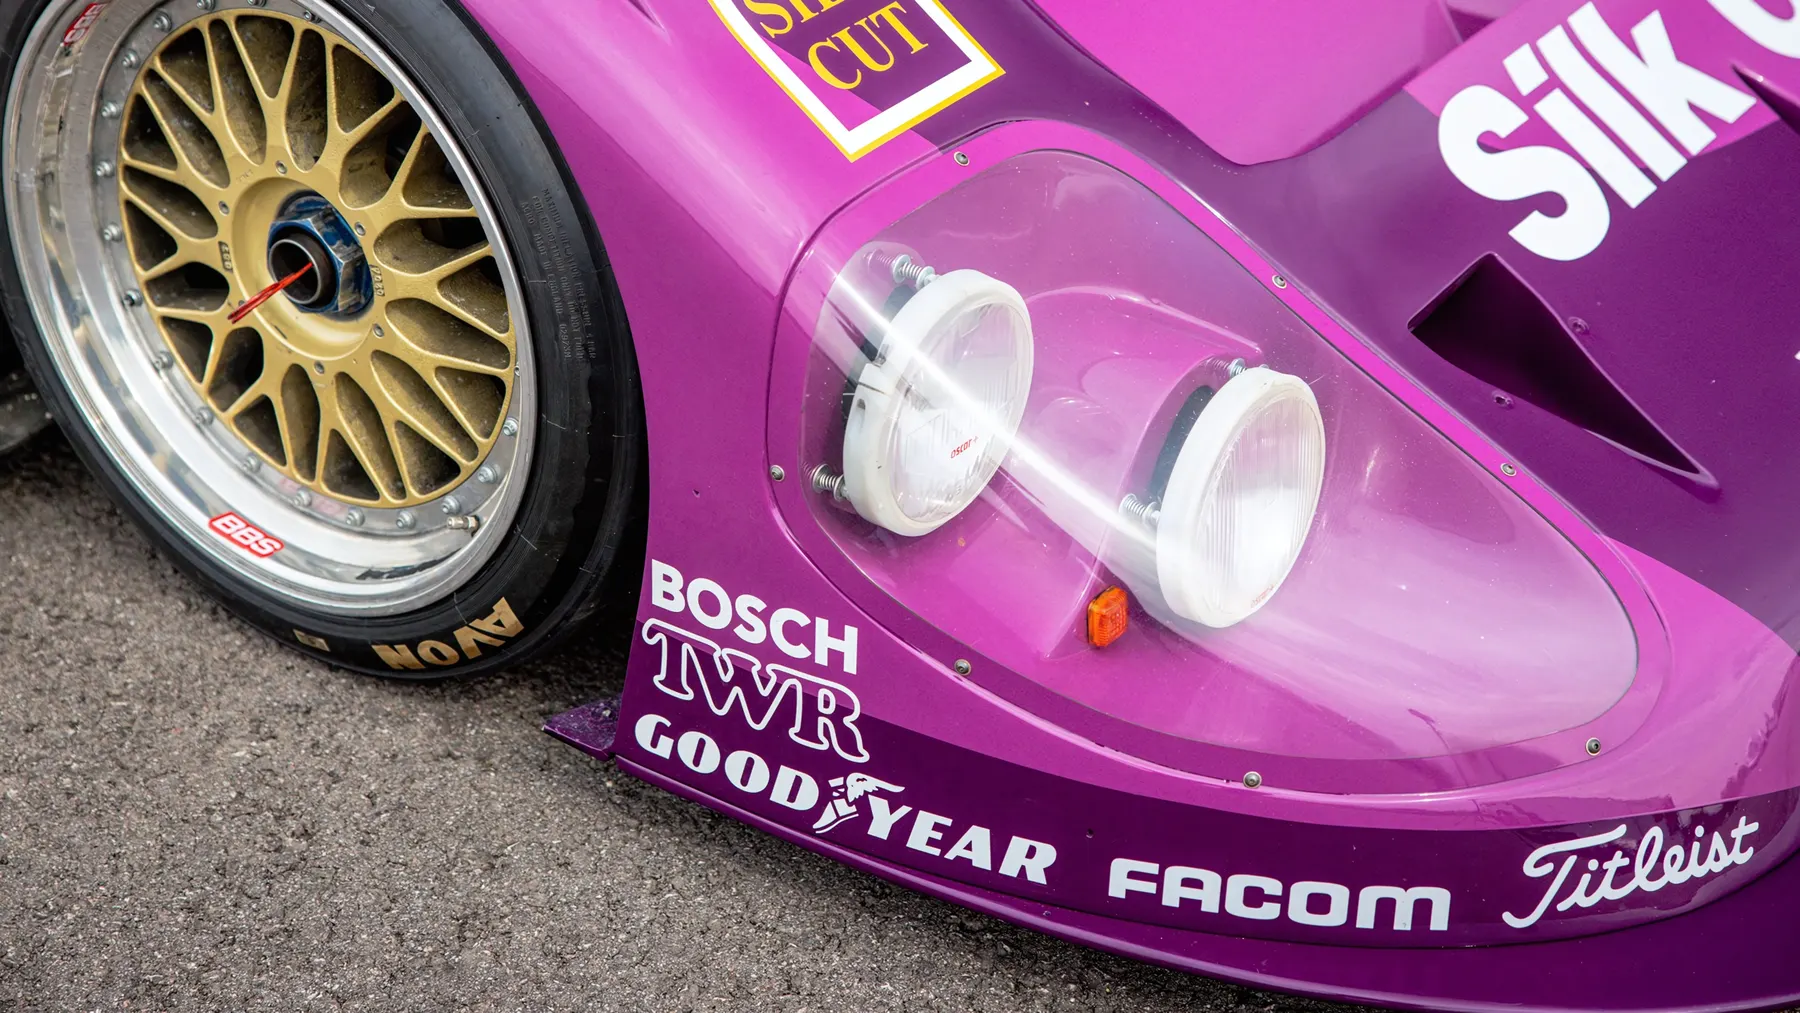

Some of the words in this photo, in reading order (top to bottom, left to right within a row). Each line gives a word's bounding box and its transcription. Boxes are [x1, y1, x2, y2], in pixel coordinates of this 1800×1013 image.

[808, 0, 930, 90] CUT
[1438, 0, 1757, 261] Silk
[211, 512, 284, 558] BBS
[371, 596, 525, 670] AVON
[651, 558, 859, 675] BOSCH
[641, 617, 870, 763] TWR
[1107, 857, 1452, 931] FACOM
[1501, 815, 1760, 929] Titleist
